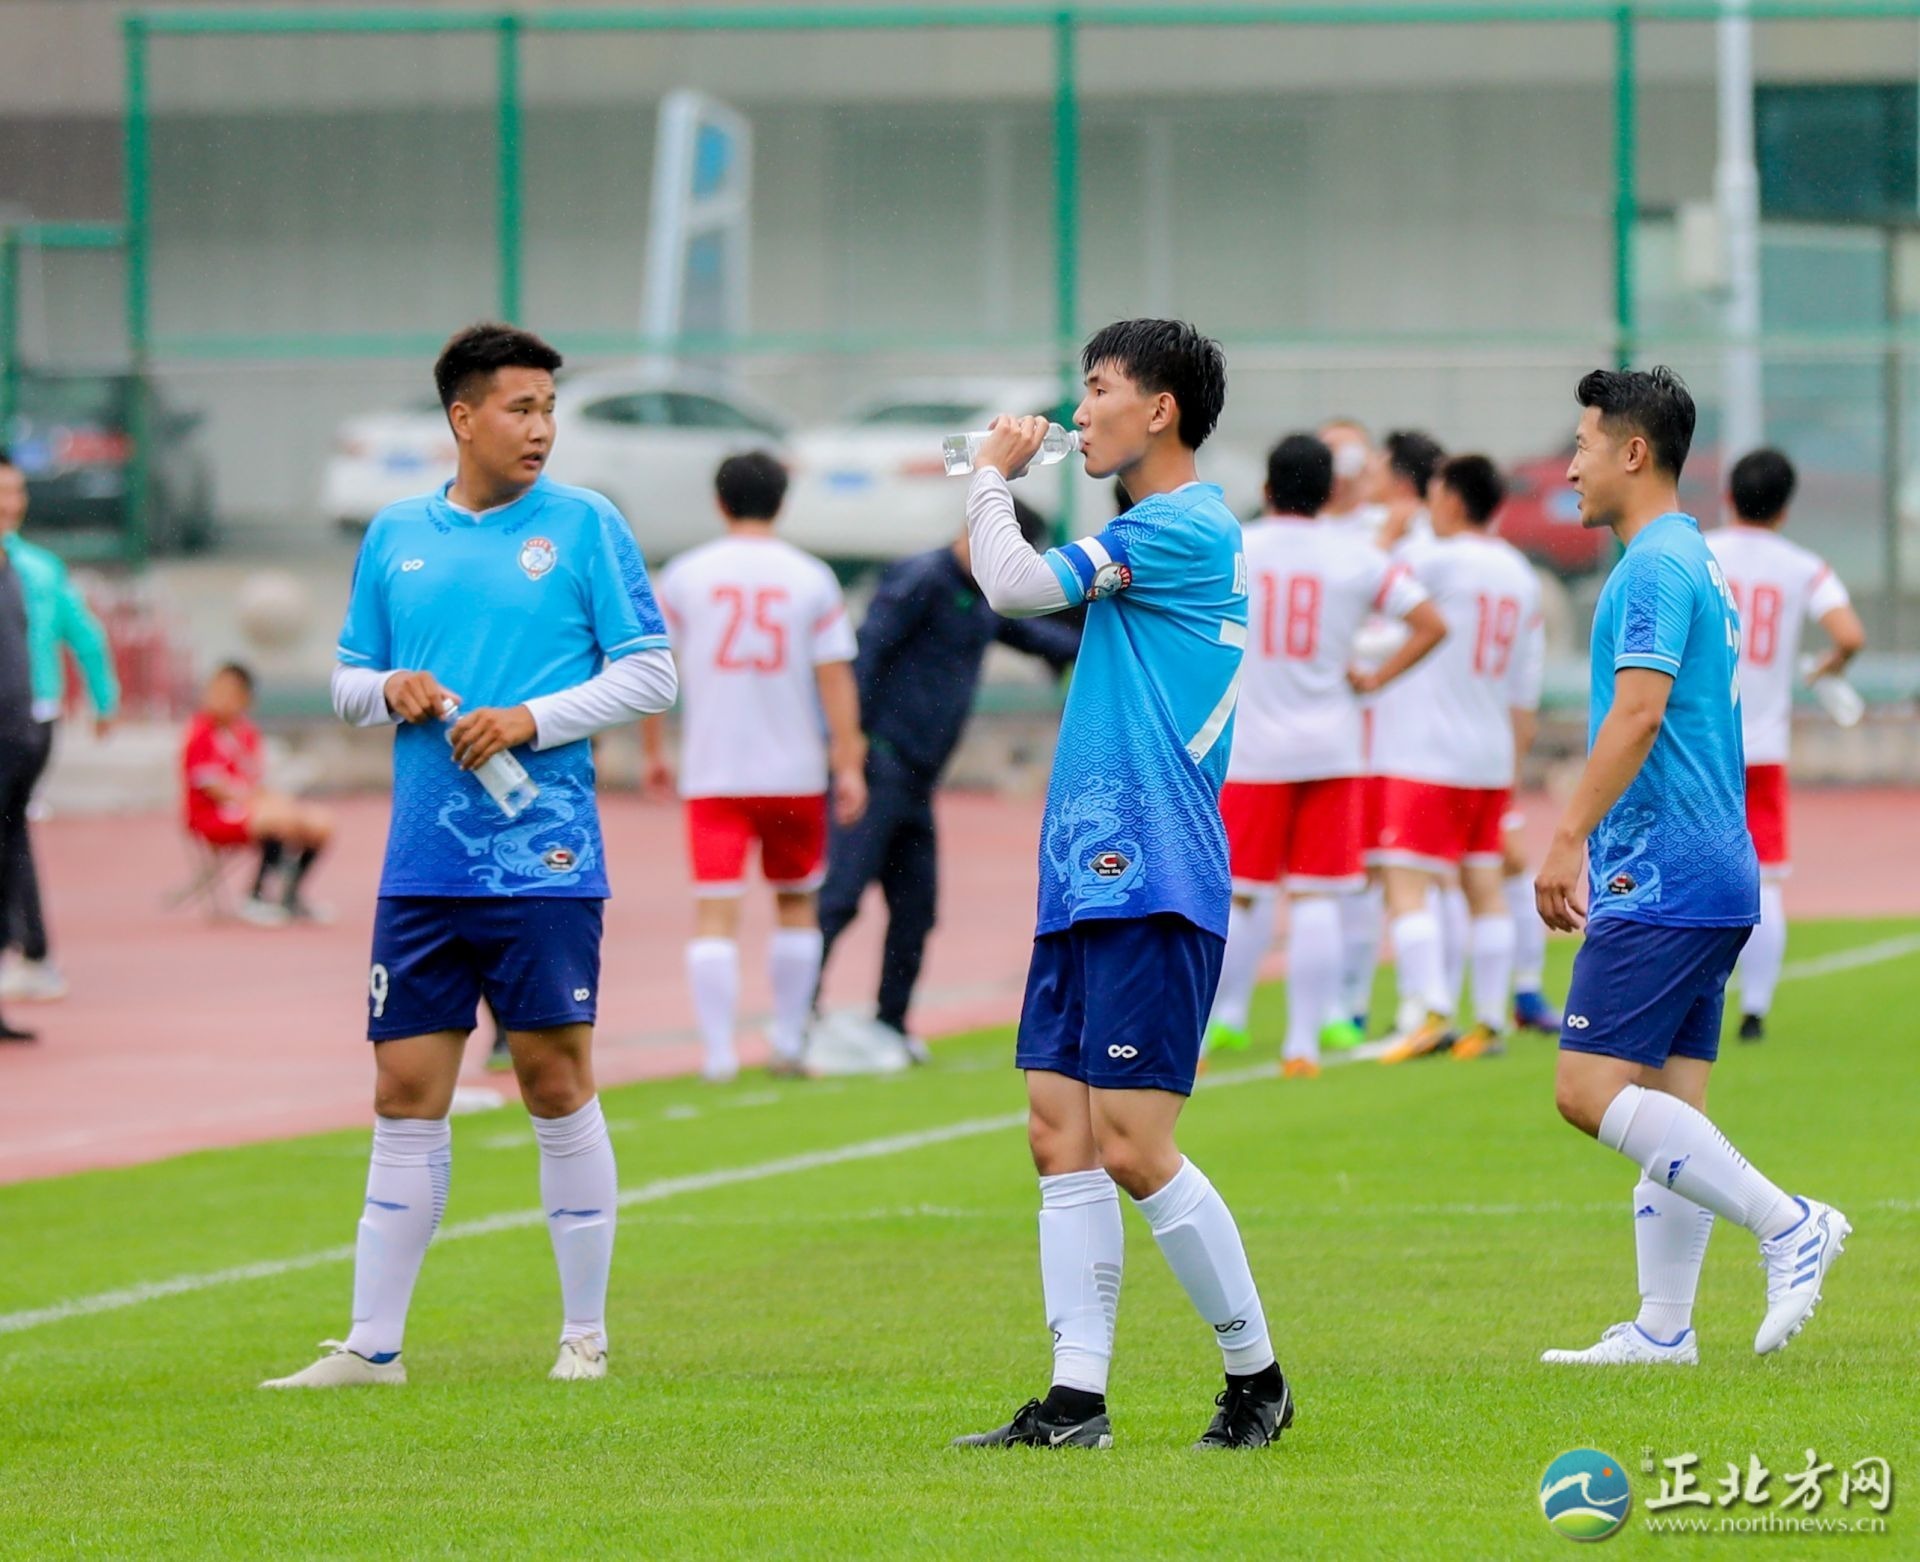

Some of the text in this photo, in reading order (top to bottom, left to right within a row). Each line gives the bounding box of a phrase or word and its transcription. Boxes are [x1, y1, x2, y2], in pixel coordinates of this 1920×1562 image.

[711, 584, 788, 674] 25
[1259, 571, 1321, 660] 18
[1473, 593, 1520, 677] 19
[370, 963, 389, 1018] 9
